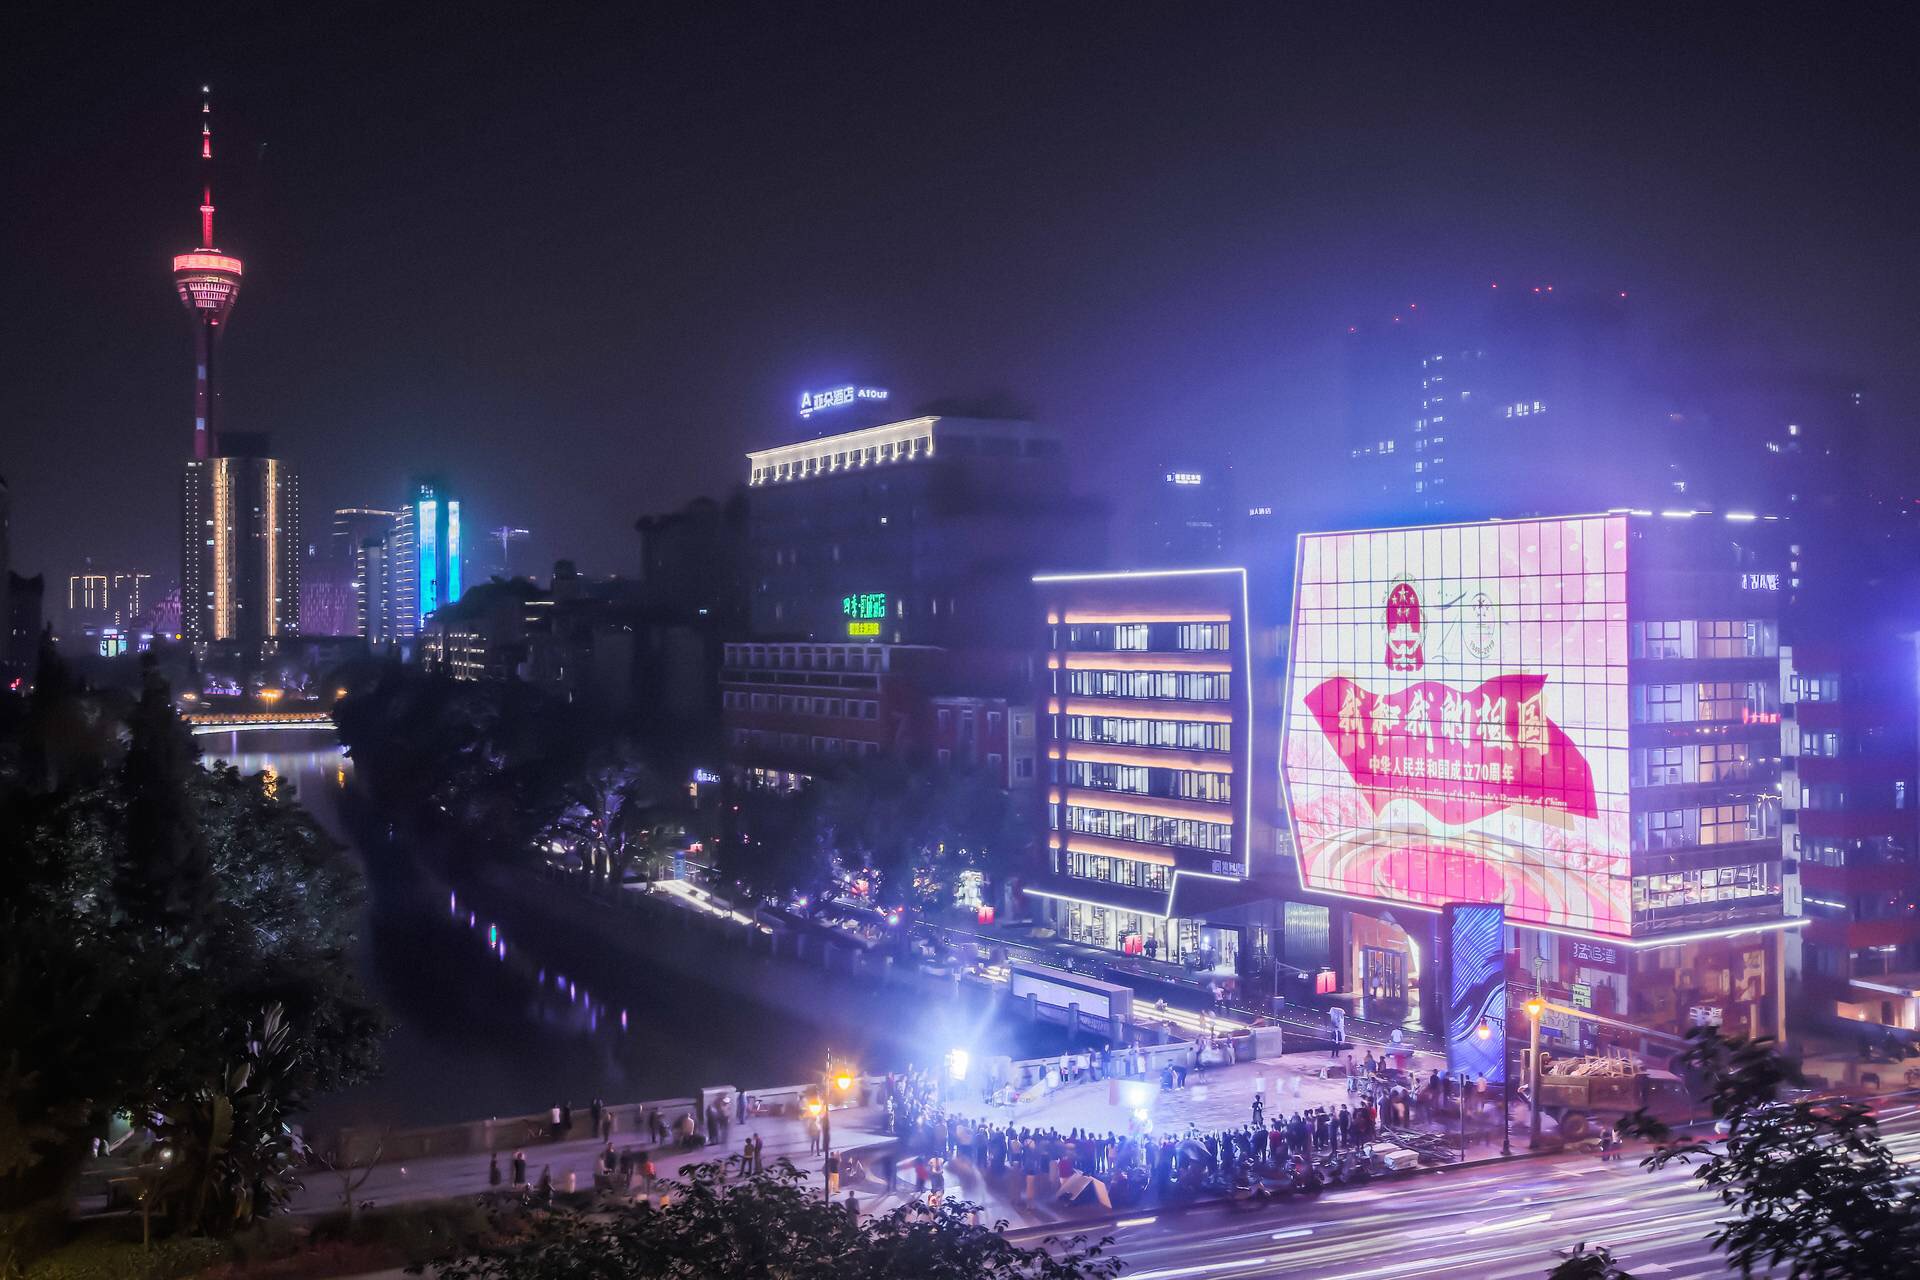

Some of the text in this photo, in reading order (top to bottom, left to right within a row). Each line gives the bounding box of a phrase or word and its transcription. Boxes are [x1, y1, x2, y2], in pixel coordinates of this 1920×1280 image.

[814, 387, 854, 410] 亚朵酒店
[858, 389, 888, 399] Atour
[1338, 687, 1549, 756] 我和我的祖国
[1368, 755, 1515, 785] 中华人民共和国成立70周年
